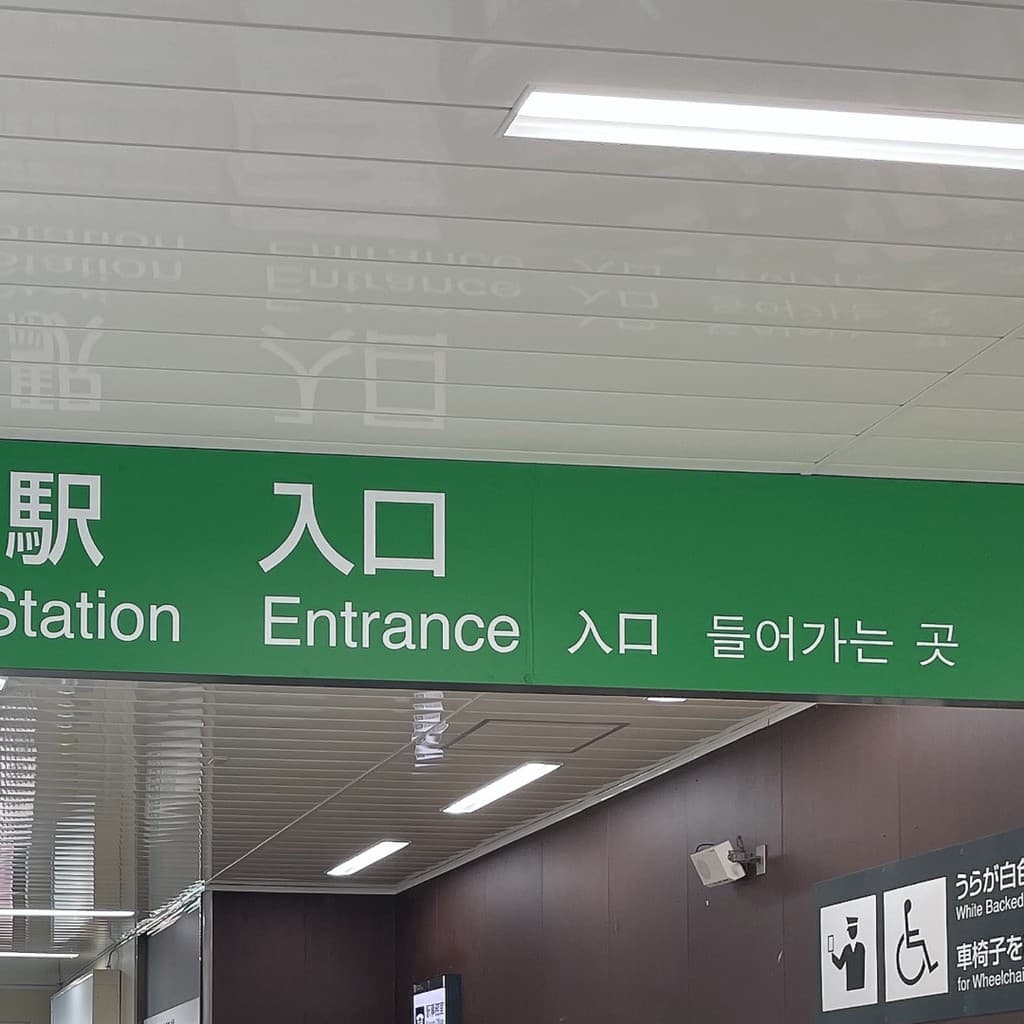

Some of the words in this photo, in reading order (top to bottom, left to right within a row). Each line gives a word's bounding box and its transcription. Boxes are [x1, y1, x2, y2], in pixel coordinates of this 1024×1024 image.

[258, 481, 447, 578] 入口
[263, 595, 521, 654] Entrance
[567, 609, 659, 657] 入口
[706, 614, 895, 666] 들어가는
[915, 622, 961, 667] 곳
[956, 903, 983, 921] White
[986, 892, 1024, 915] Backed
[956, 935, 1023, 970] 車椅子を
[957, 976, 971, 992] for
